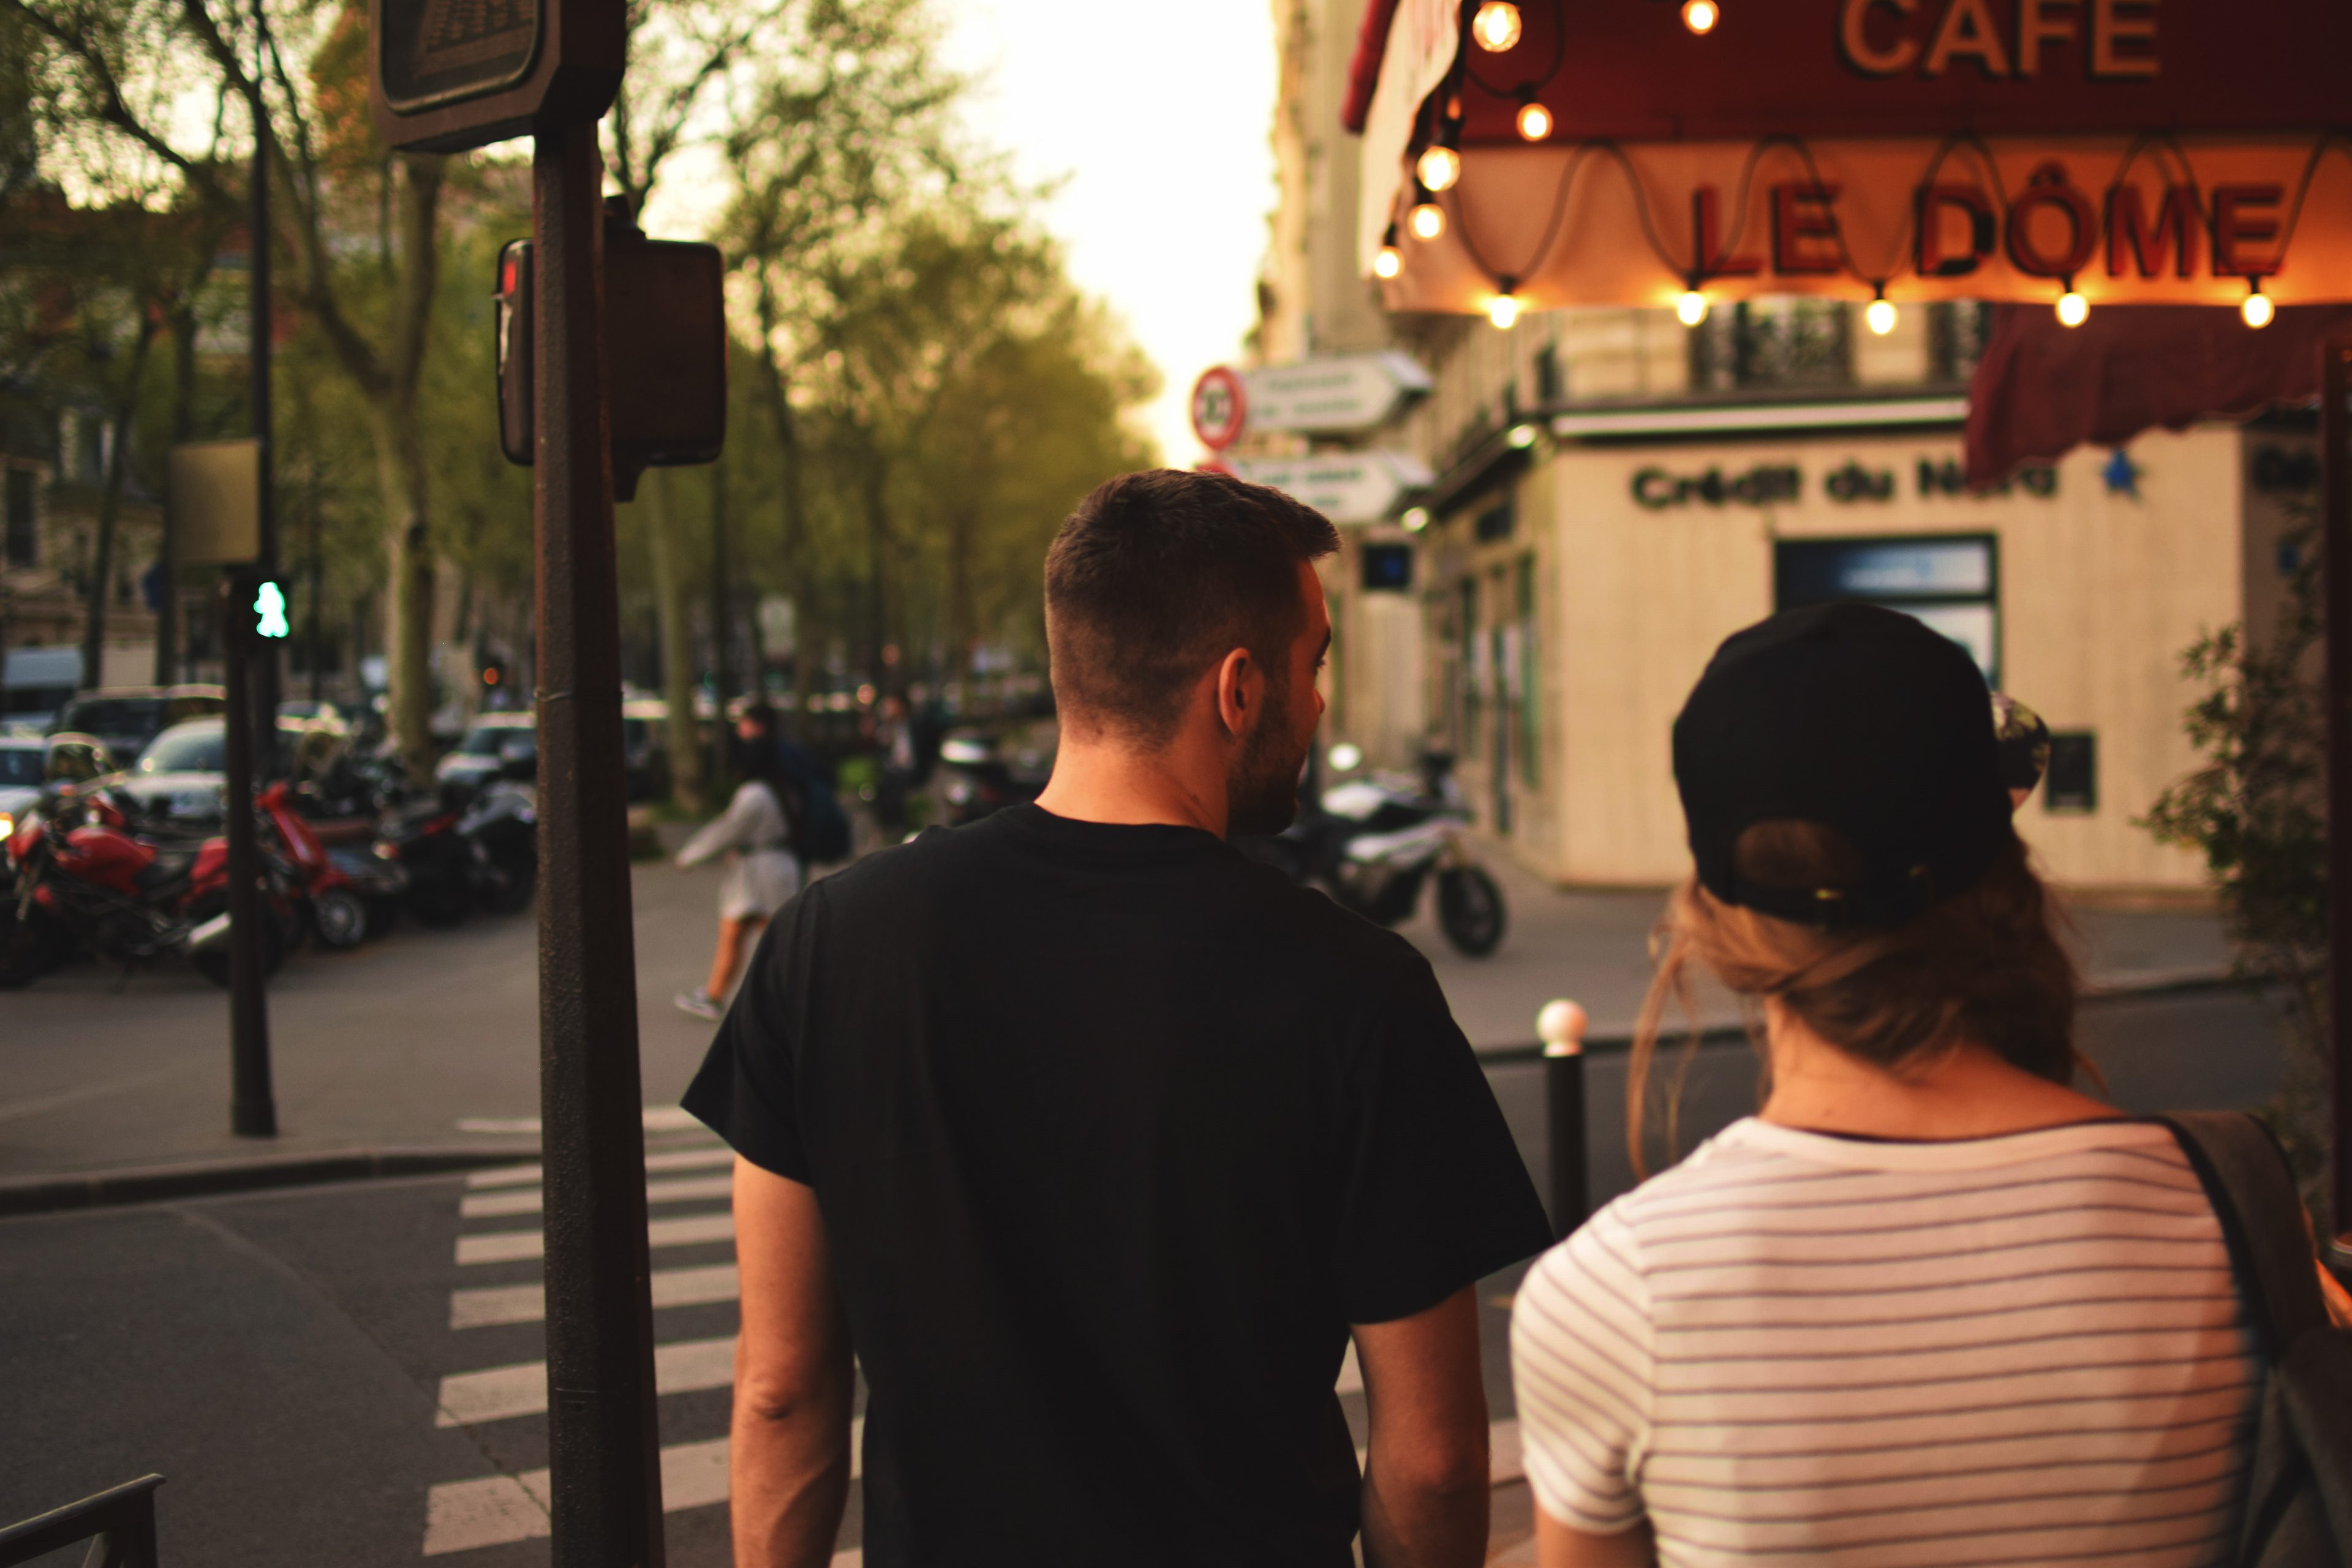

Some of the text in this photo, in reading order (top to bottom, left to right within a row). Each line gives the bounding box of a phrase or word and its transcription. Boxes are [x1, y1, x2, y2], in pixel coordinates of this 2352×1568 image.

[1693, 160, 2286, 277] LE DÔME
[1825, 462, 1894, 503] du
